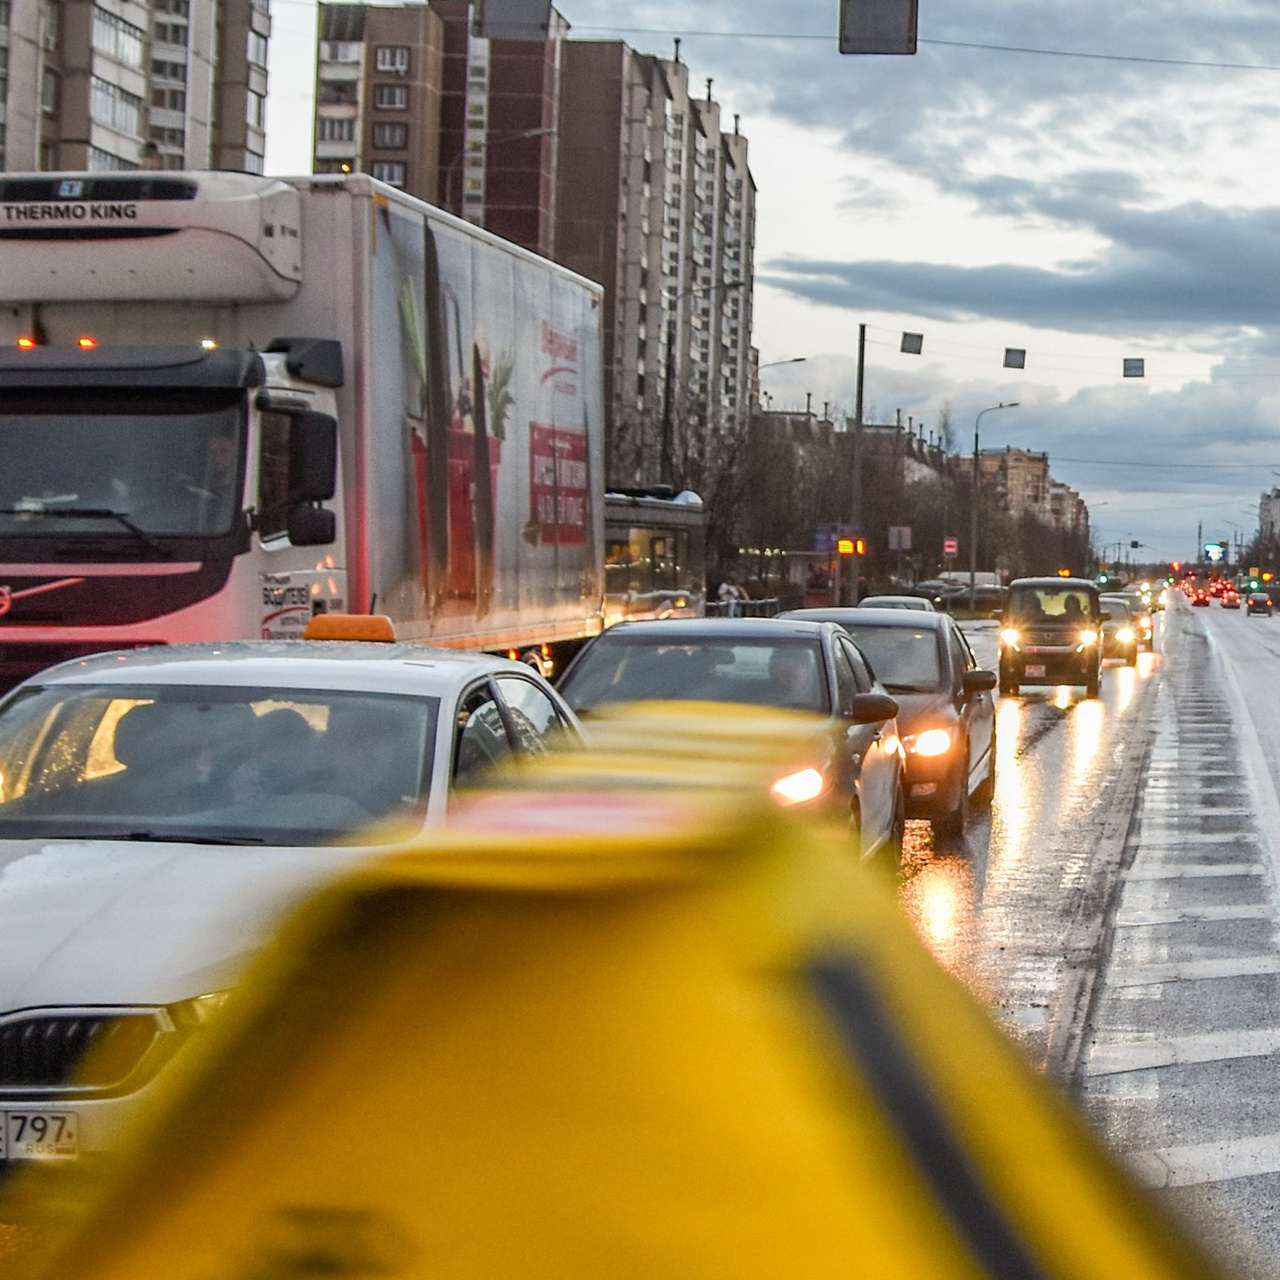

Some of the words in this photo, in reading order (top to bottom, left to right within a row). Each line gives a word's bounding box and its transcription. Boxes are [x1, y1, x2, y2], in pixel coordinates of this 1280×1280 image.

[3, 204, 86, 220] THERMO
[90, 204, 137, 220] KING
[11, 1115, 67, 1143] 797
[25, 1143, 54, 1154] RUS
